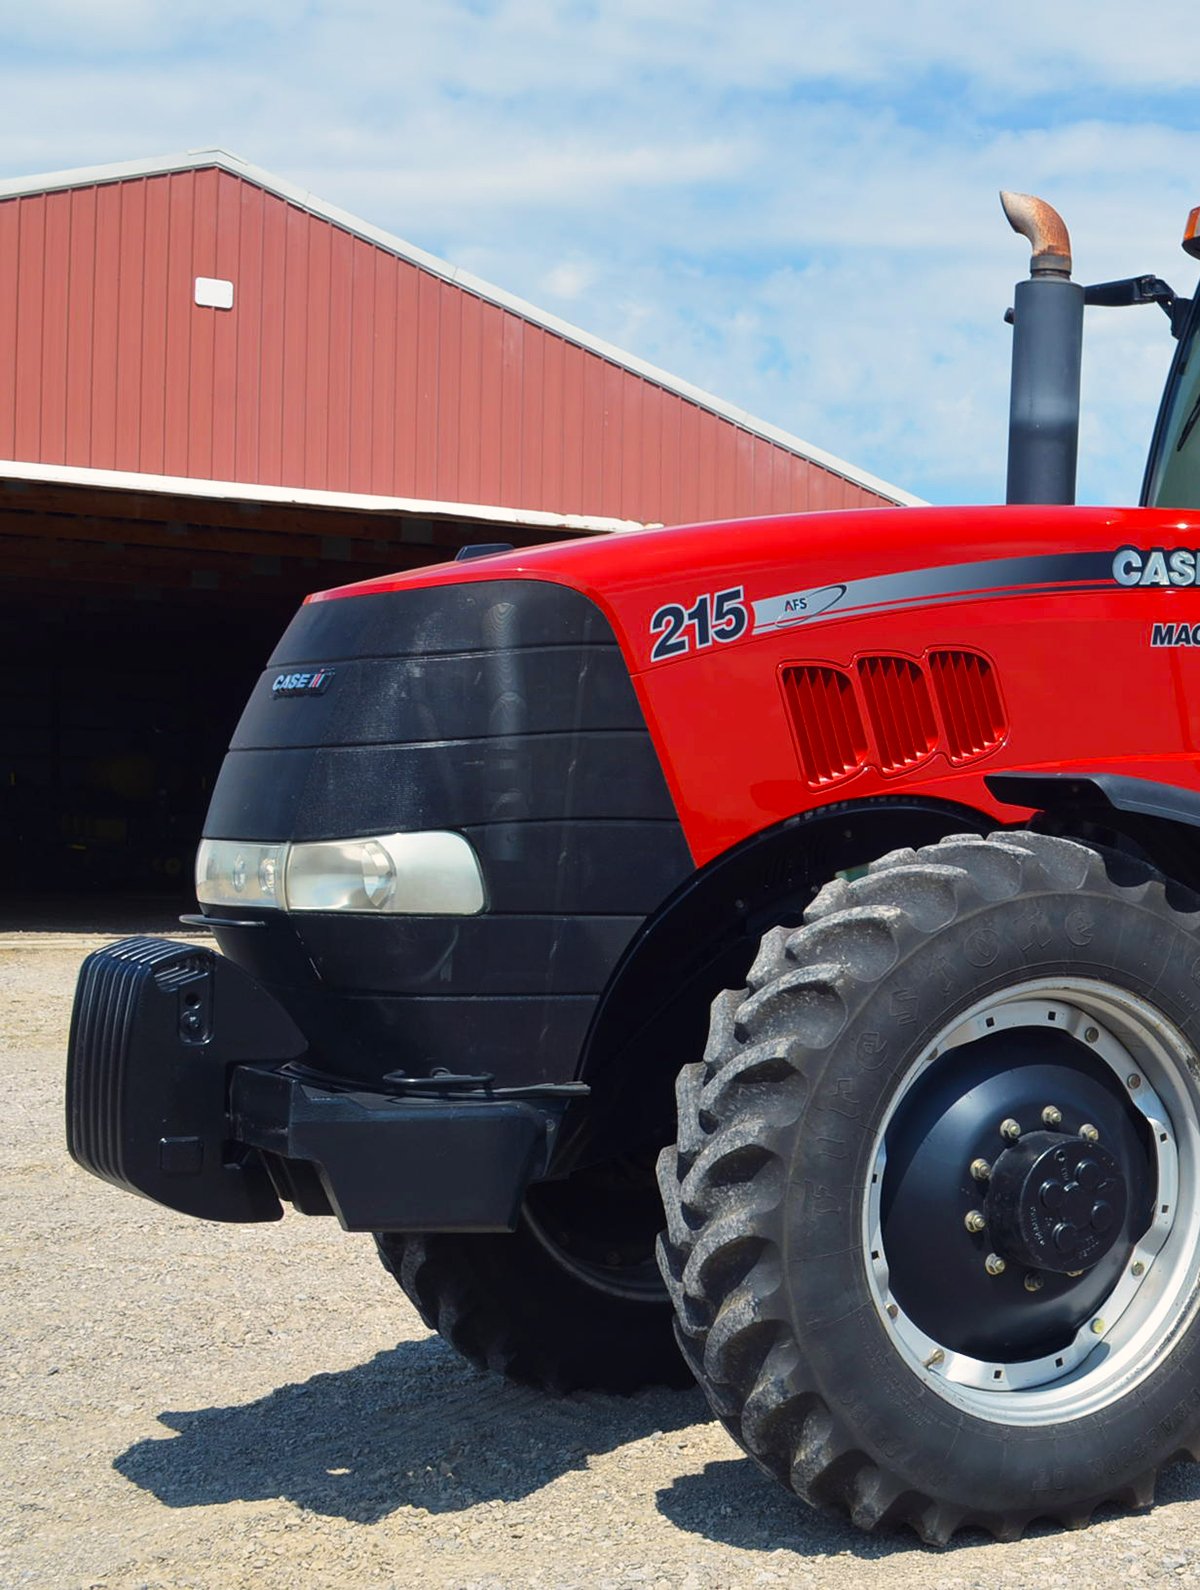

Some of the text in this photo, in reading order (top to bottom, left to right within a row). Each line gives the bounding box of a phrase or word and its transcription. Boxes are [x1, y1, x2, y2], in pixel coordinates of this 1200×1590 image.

[650, 585, 748, 663] 215
[785, 598, 808, 612] AFS
[272, 673, 311, 691] CASE
[800, 900, 1098, 1222] Firestone
